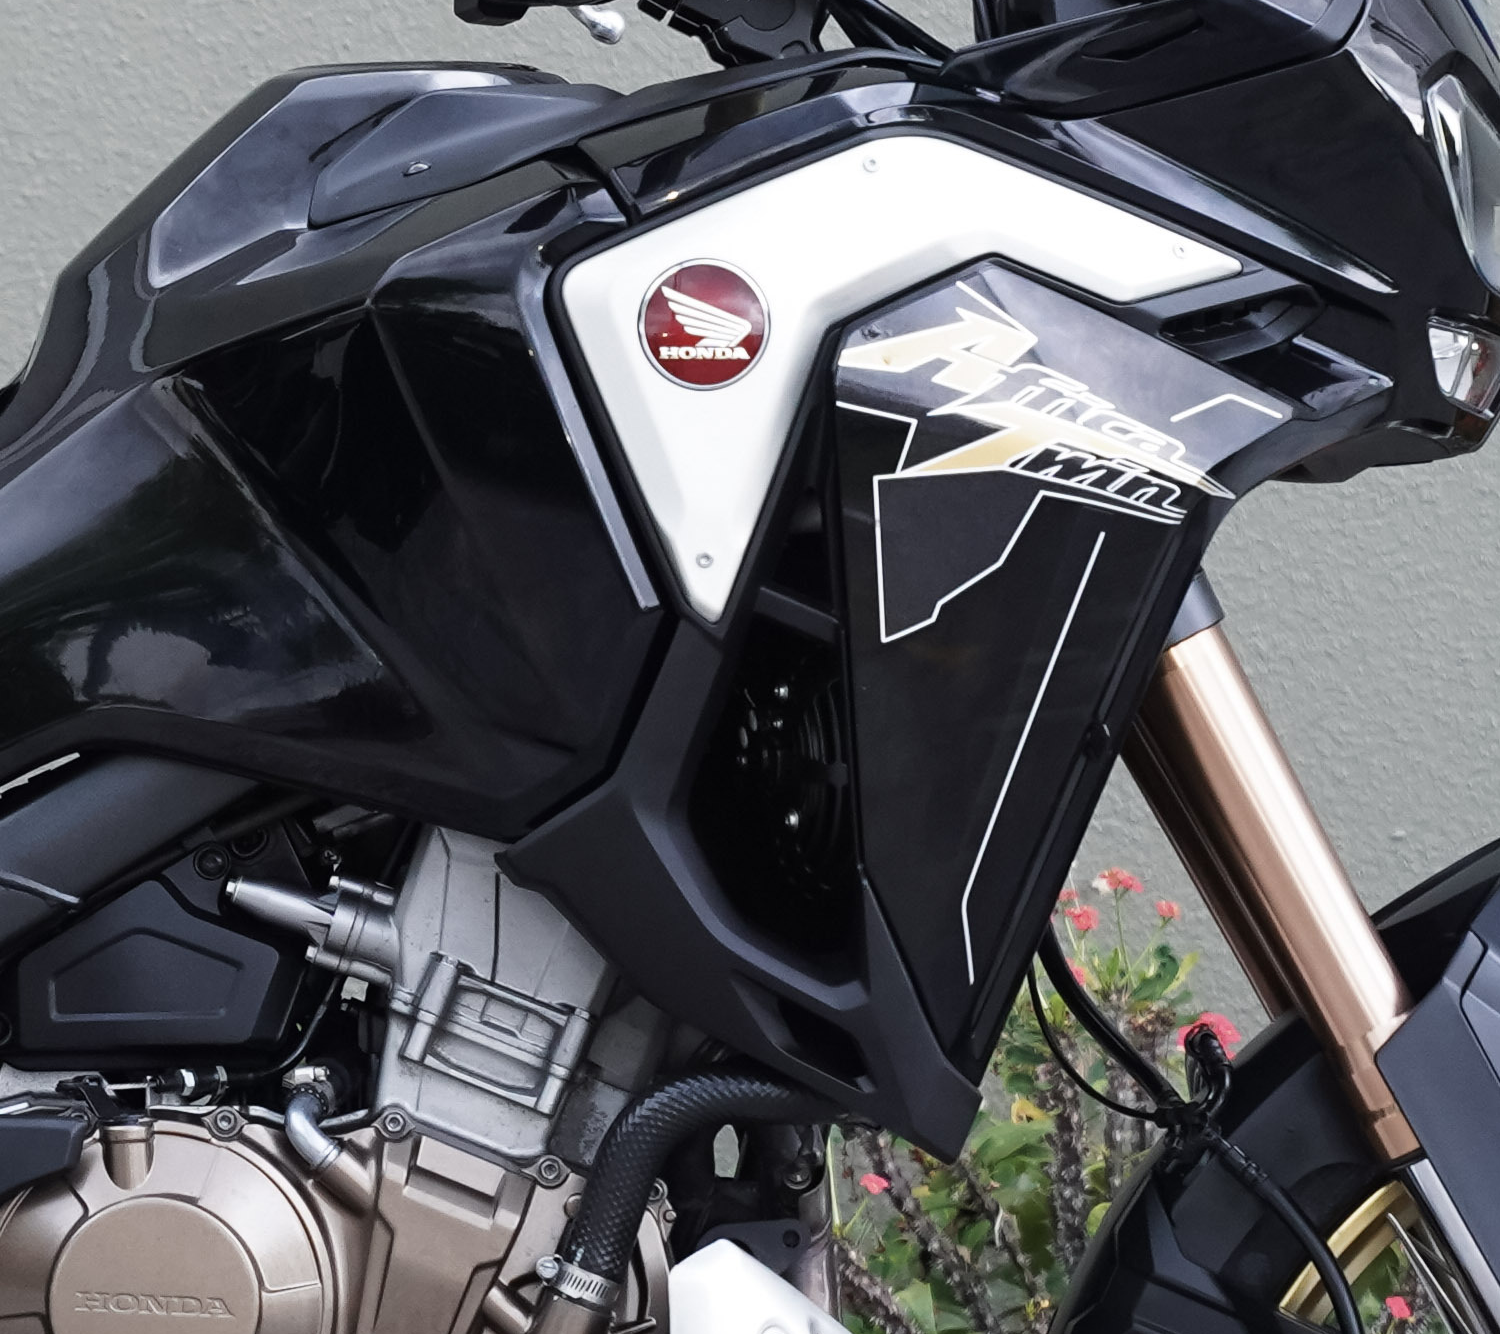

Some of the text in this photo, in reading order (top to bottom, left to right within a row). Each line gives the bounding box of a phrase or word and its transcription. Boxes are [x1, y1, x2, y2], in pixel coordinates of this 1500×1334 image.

[659, 346, 751, 360] HONDA
[838, 305, 1206, 477] Africa
[75, 1291, 235, 1318] HONDA
